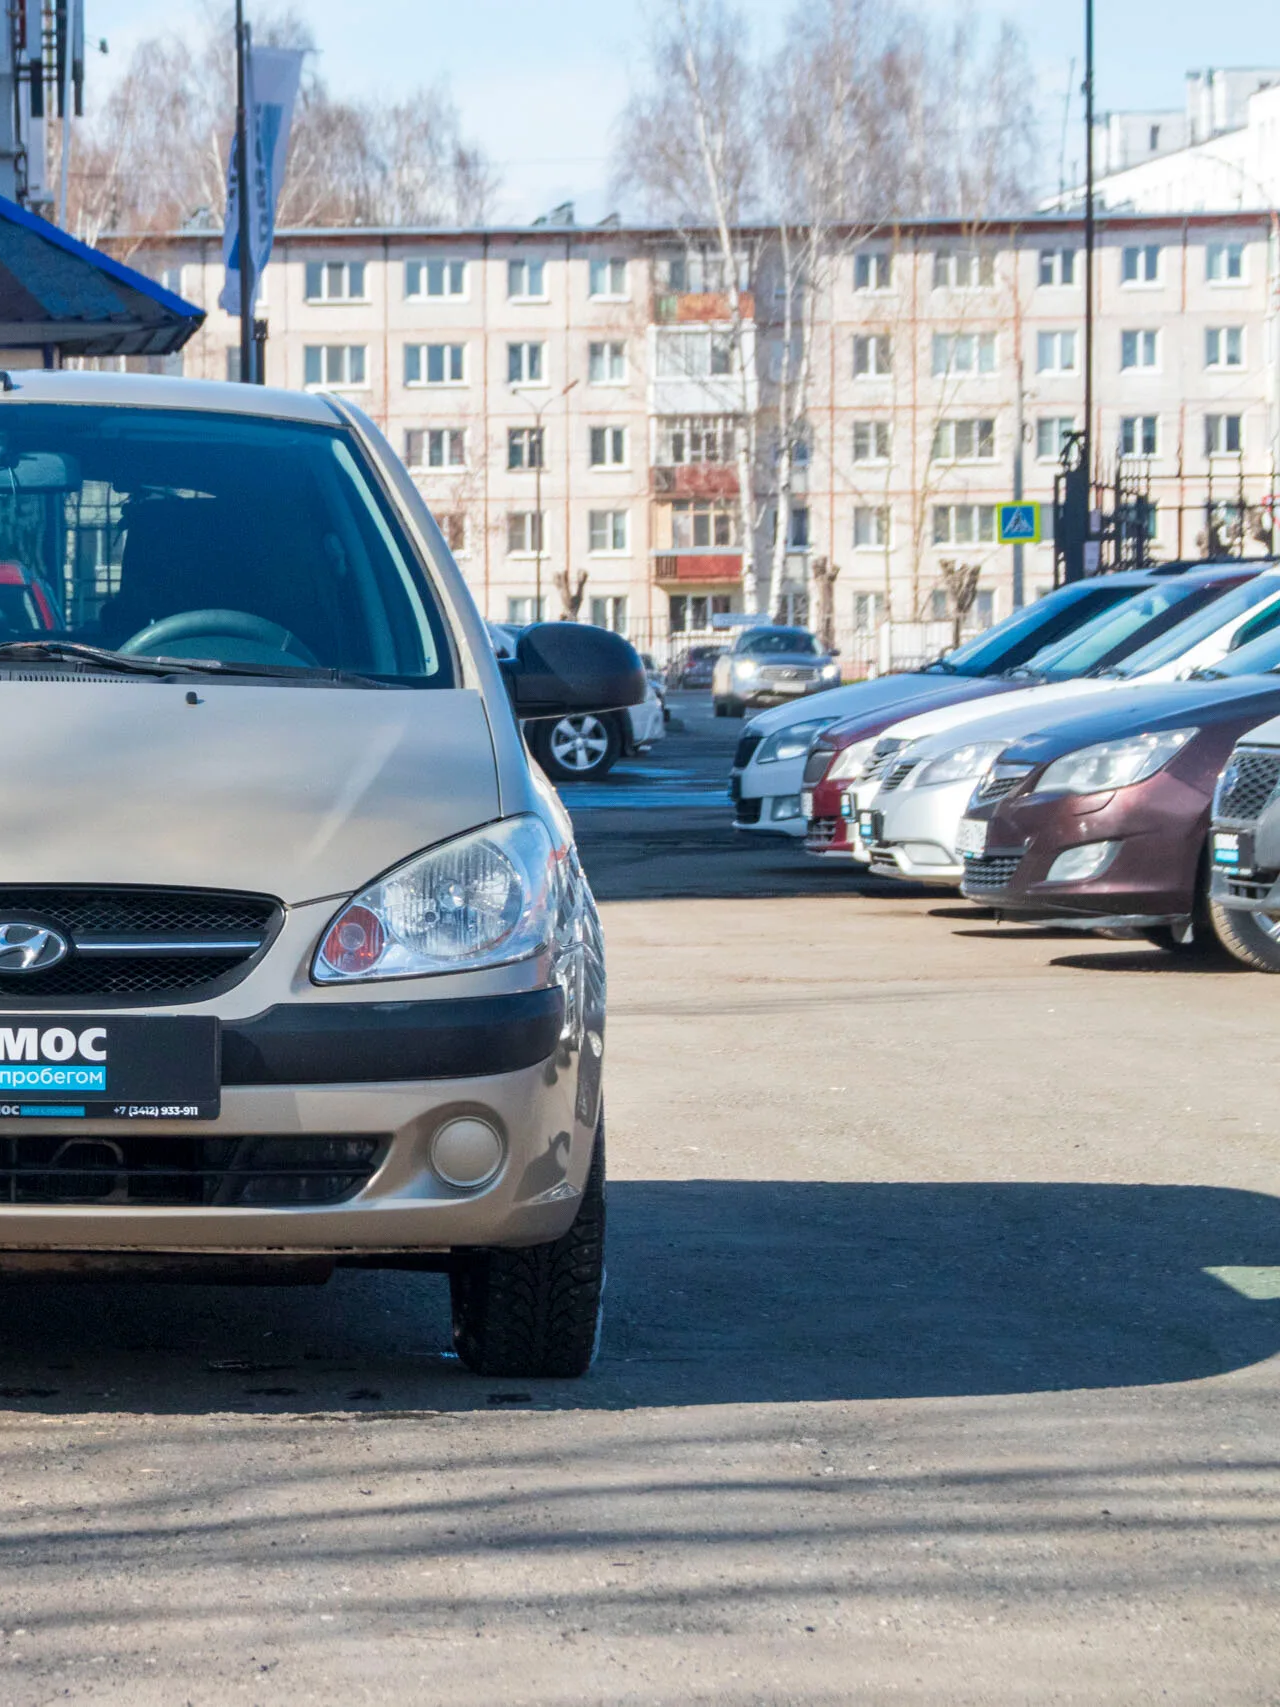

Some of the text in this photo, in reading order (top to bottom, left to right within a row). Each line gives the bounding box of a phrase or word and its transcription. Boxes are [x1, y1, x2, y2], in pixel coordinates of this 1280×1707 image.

[0, 1068, 104, 1087] пробегом
[113, 1105, 198, 1117] +7 (3412) 933-911
